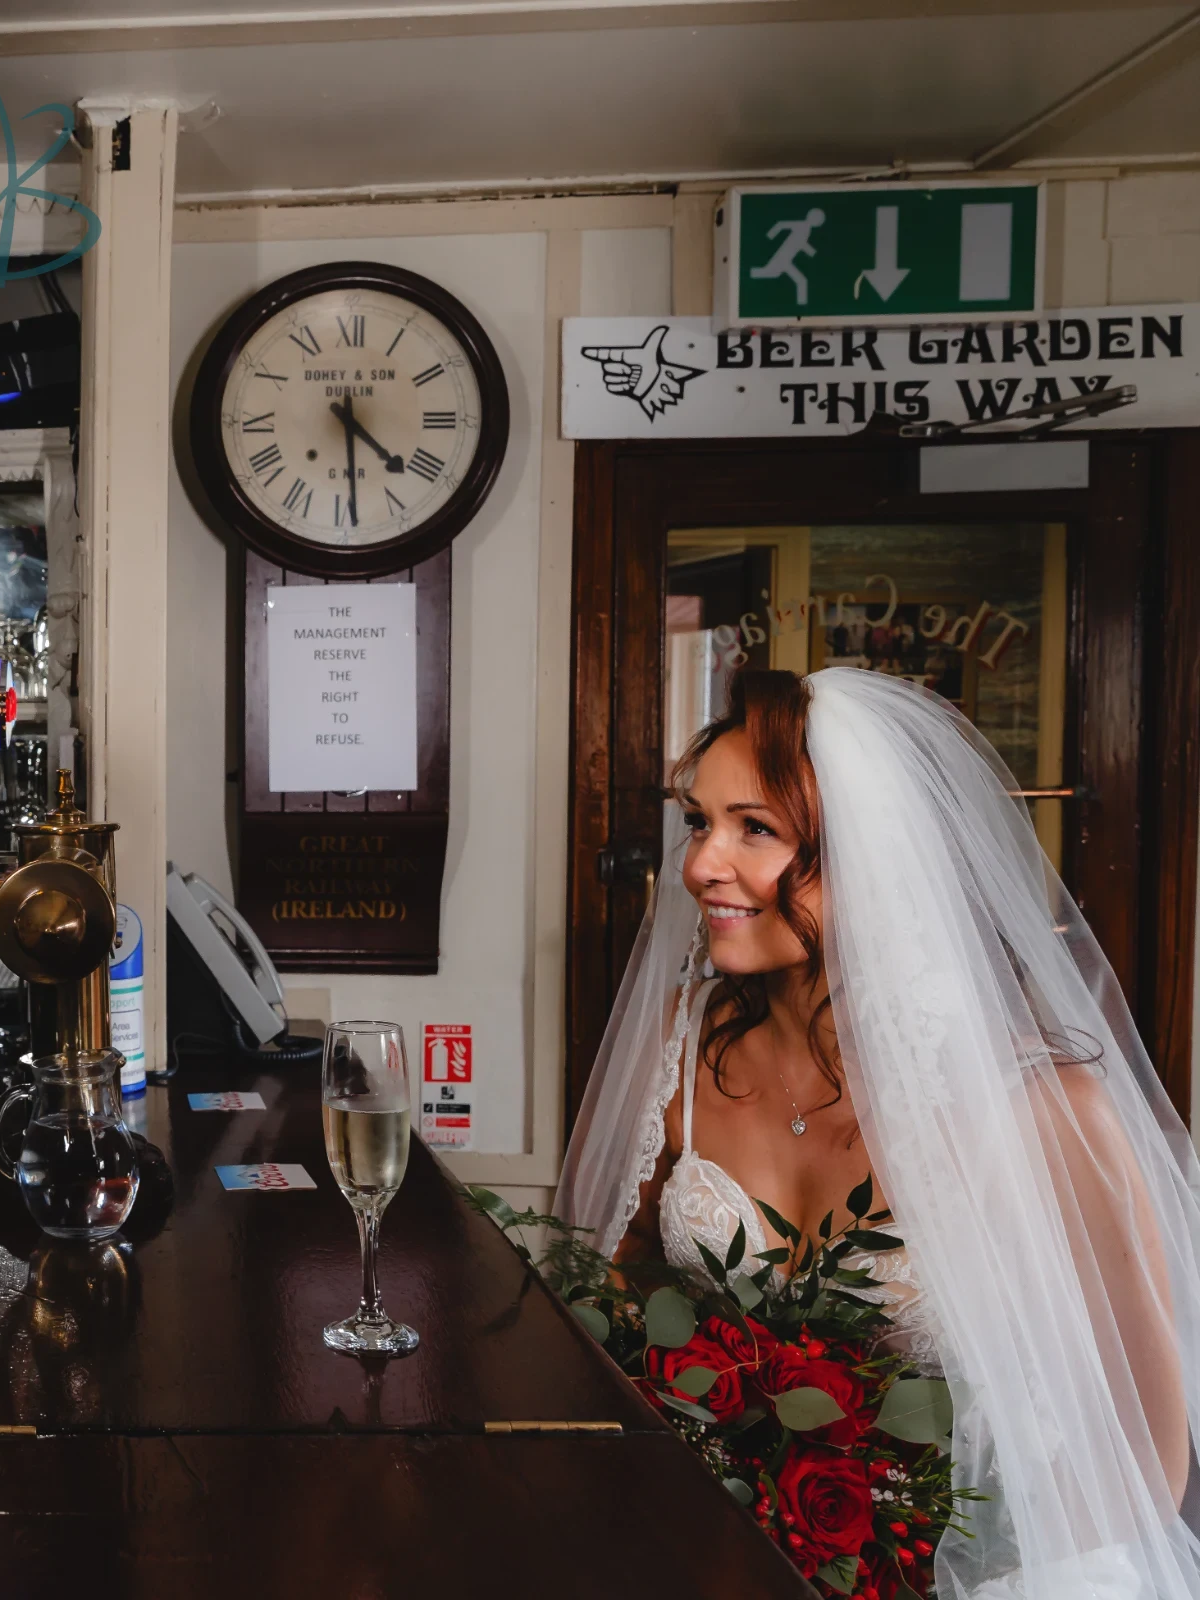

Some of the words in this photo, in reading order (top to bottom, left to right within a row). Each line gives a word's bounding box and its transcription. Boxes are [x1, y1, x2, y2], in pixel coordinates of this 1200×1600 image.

[716, 328, 884, 370] BEER
[908, 315, 1184, 366] GARDEN
[304, 369, 346, 381] DOHEY
[354, 369, 364, 381] &
[370, 369, 395, 381] SON
[780, 380, 929, 424] THIS
[956, 375, 1112, 421] WAY
[328, 606, 352, 618] THE
[294, 626, 387, 640] MANAGEMENT
[313, 648, 367, 661] RESERVE
[328, 669, 352, 682] THE
[321, 691, 360, 703] RIGHT
[331, 713, 349, 724] TO
[299, 836, 390, 853] GREAT
[271, 899, 408, 922] (IRELAND)
